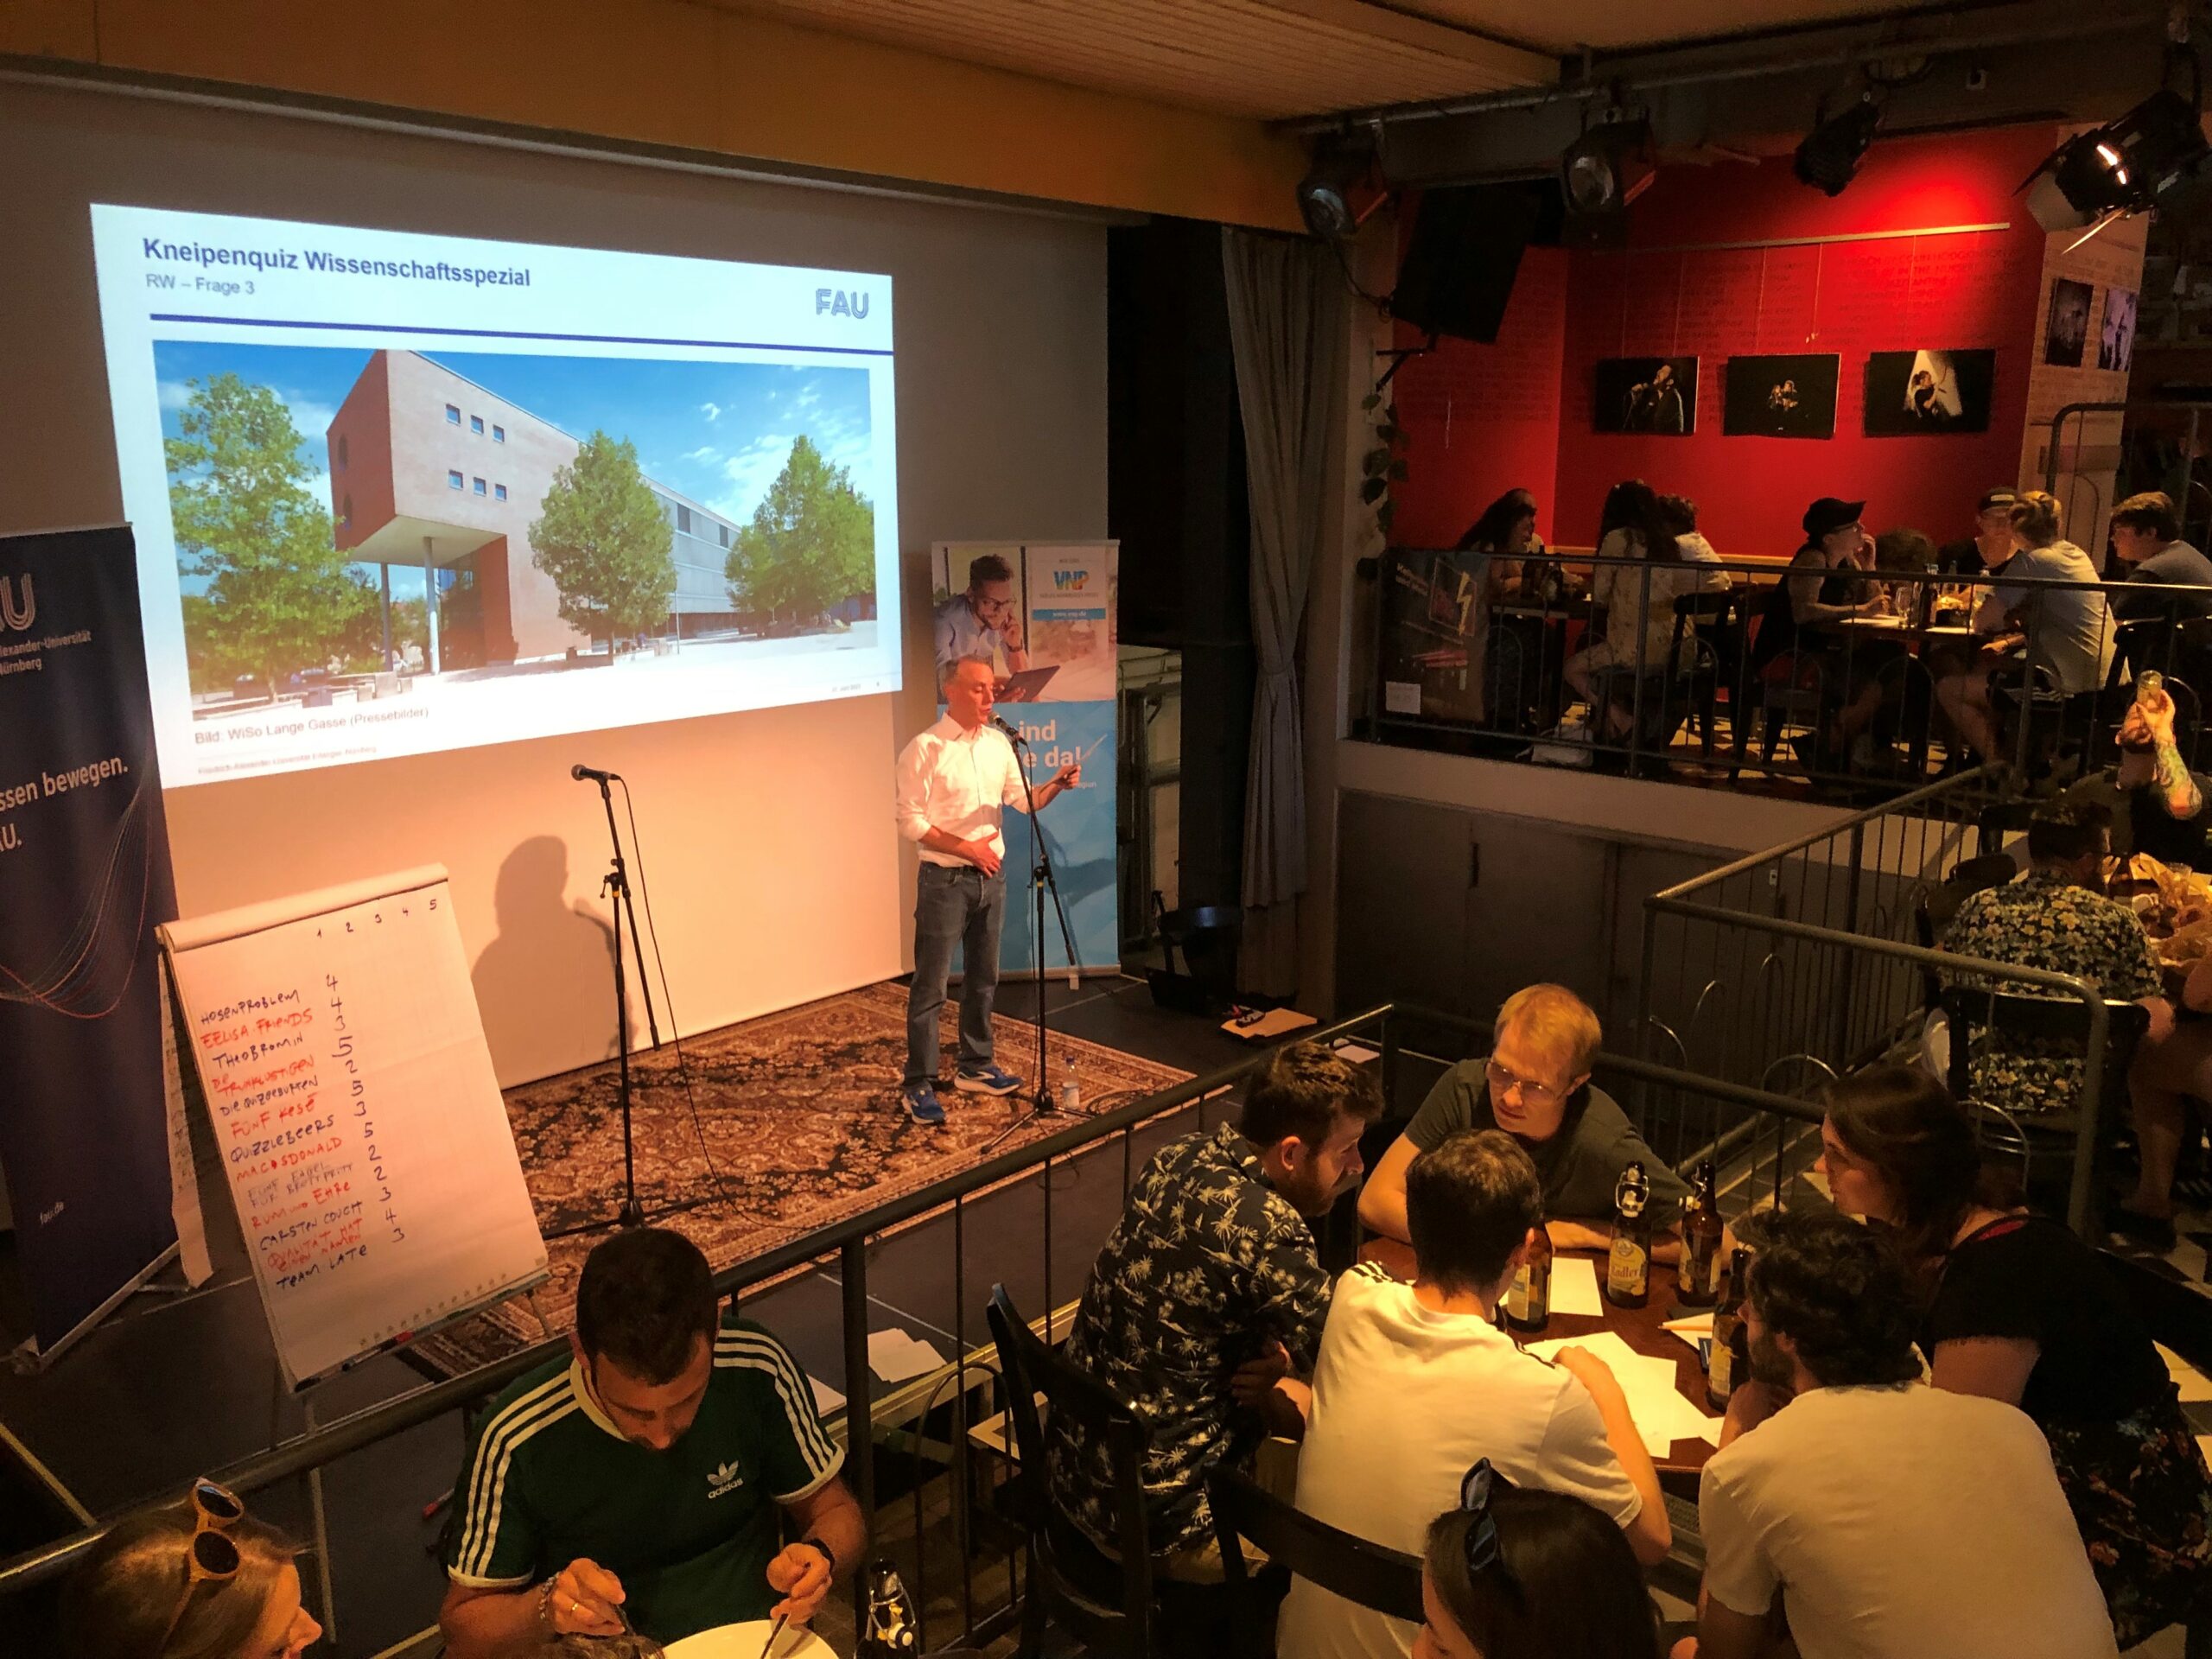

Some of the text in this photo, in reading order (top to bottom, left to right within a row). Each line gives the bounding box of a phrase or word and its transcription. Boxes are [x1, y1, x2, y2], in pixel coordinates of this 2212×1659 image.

[143, 237, 531, 289] Kneipenquiz Wissenschaftsspezial
[145, 273, 175, 289] RW
[195, 276, 240, 296] Frage
[245, 281, 255, 295] 3
[816, 288, 868, 319] FAU
[0, 630, 92, 658] lexander-Universität
[0, 657, 42, 677] ürnberg
[227, 727, 264, 742] WiSo
[266, 722, 305, 736] Lange
[308, 716, 346, 730] Gasse
[350, 708, 429, 728] (Pressebilder)
[1019, 719, 1056, 741] ind
[0, 756, 128, 811] ssen bewegen.
[0, 823, 22, 853] U.
[316, 899, 436, 938] 1 2 3 4 5
[326, 974, 338, 991] 4
[331, 997, 342, 1013] 4
[334, 1015, 346, 1031] 3
[332, 1035, 353, 1058] 5
[345, 1059, 358, 1074] 2
[351, 1080, 364, 1096] 5
[353, 1101, 366, 1116] 3
[364, 1122, 373, 1138] 5
[368, 1145, 381, 1160] 2
[374, 1166, 386, 1181] 2
[378, 1186, 391, 1202] 3
[385, 1209, 397, 1224] 4
[391, 1228, 405, 1243] 3
[708, 1478, 743, 1499] adidas
